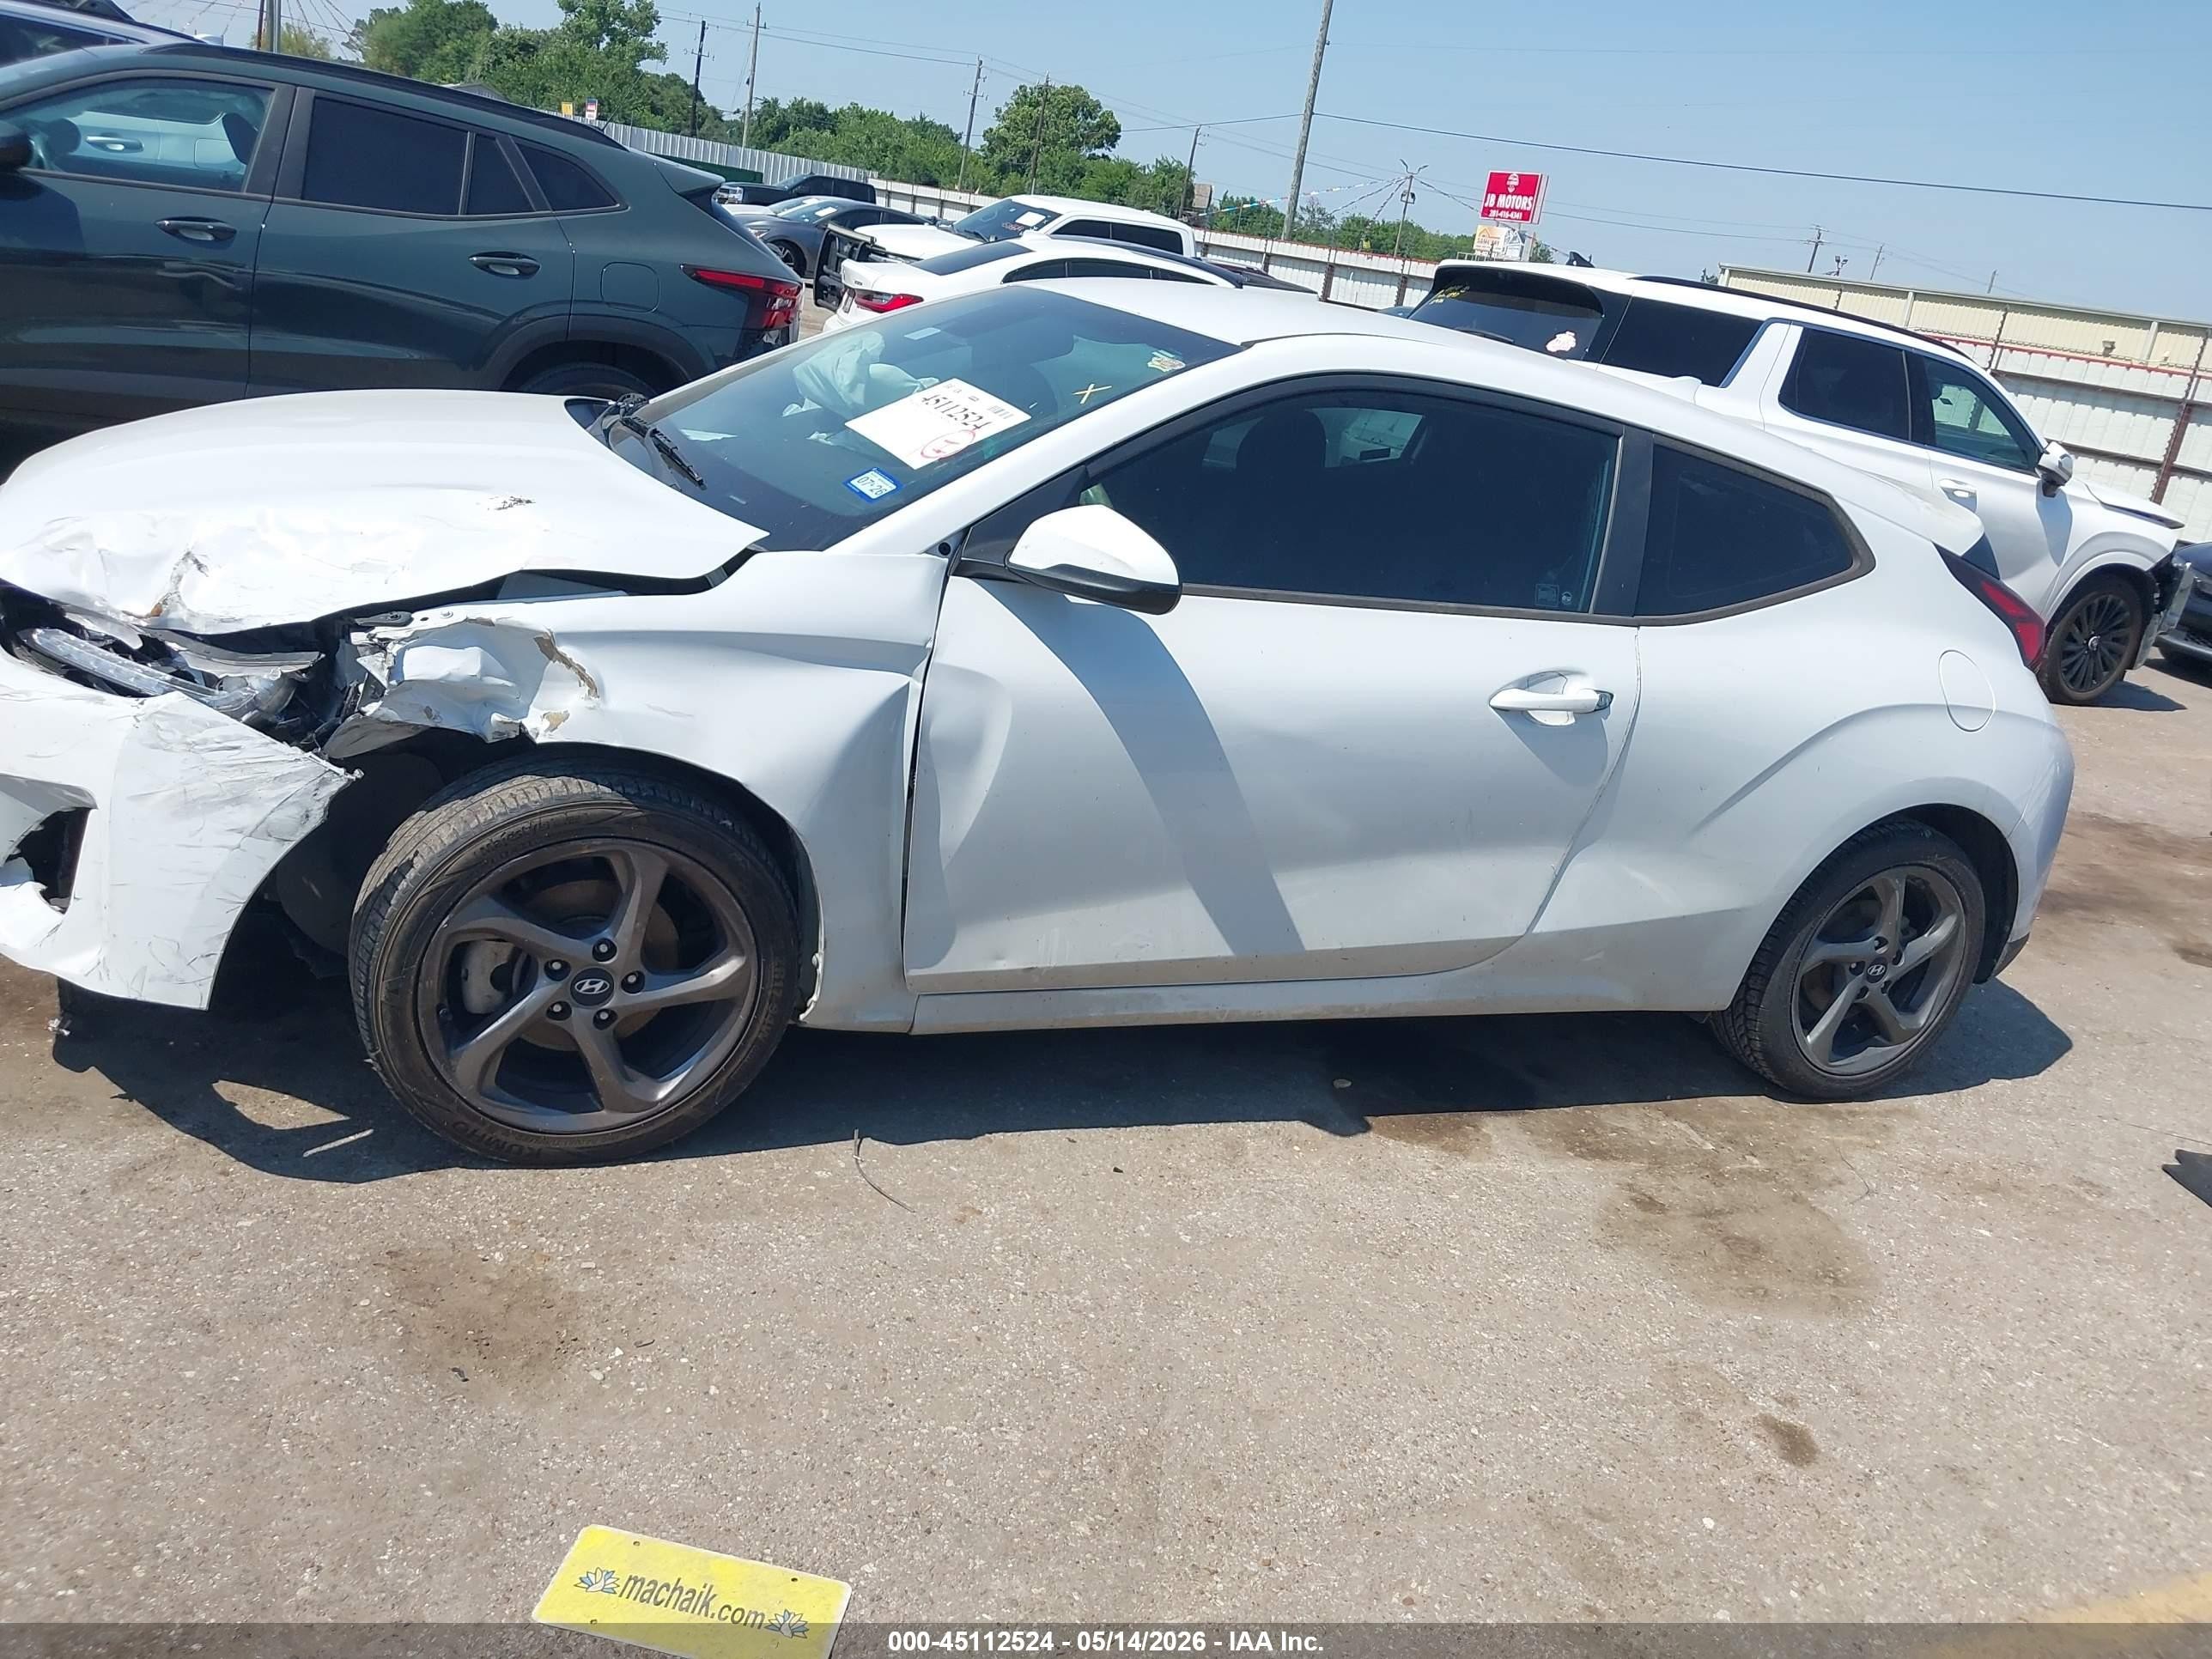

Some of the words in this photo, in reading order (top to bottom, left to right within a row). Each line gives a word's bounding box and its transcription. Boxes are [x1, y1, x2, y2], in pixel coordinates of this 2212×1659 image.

[1485, 193, 1496, 208] JB
[1497, 194, 1534, 211] MOTORS
[921, 394, 993, 431] 45112524
[617, 1573, 766, 1630] machaik.com
